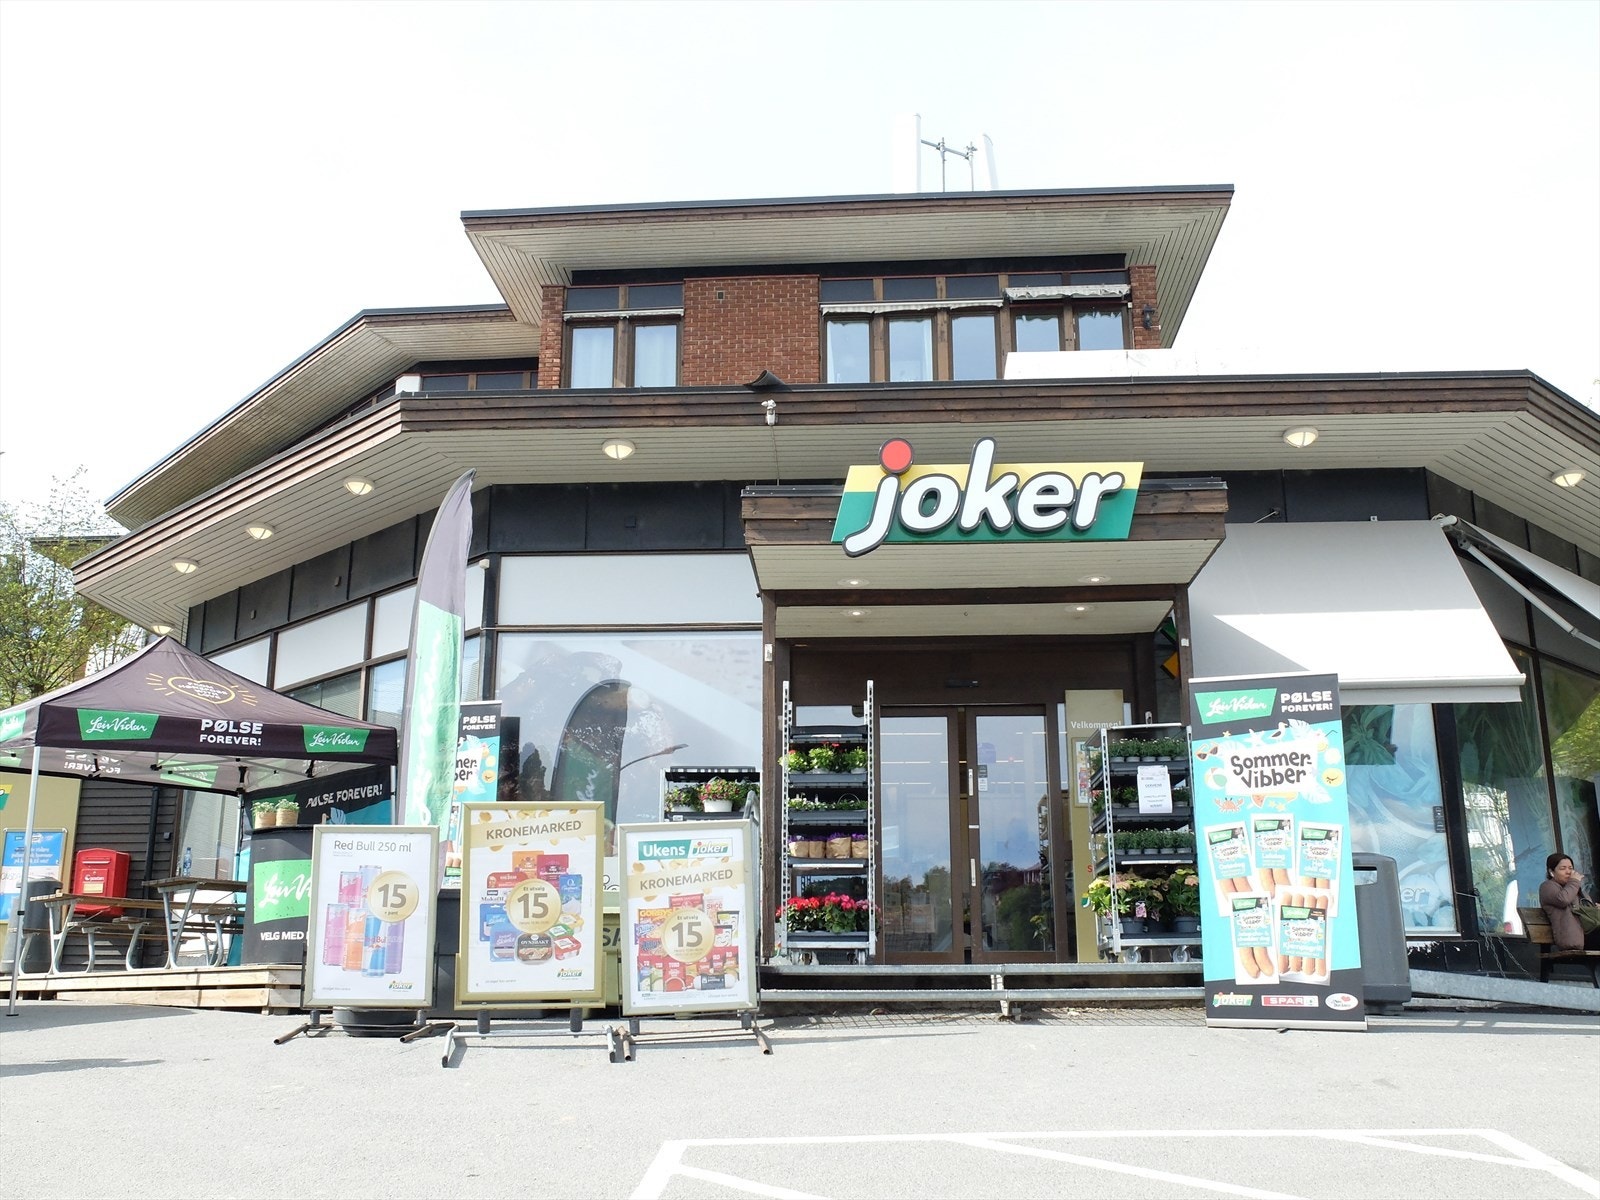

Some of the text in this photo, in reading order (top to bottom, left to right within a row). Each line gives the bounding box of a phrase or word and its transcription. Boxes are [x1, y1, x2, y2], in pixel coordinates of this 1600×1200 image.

[842, 436, 1125, 558] joker
[1280, 691, 1332, 703] PØLSE
[1281, 703, 1333, 713] FOREVER!
[113, 716, 148, 732] Vidar
[200, 719, 264, 735] PØLSE
[462, 715, 497, 724] PØLSE
[1070, 721, 1121, 730] Velkommen!
[199, 734, 262, 746] FOREVER!
[1241, 767, 1306, 789] Vibber
[306, 784, 383, 808] PØLSE FOREVER!
[486, 820, 582, 840] KRONEMARKED
[333, 840, 412, 852] Red Bull 250 ml
[642, 841, 727, 857] Ukens joker
[640, 869, 733, 891] KRONEMARKED
[378, 883, 407, 909] 15
[517, 892, 549, 919] 15
[260, 932, 281, 941] VELG
[281, 931, 304, 940] MED
[671, 921, 703, 948] 15
[1213, 992, 1249, 1008] joker
[1269, 997, 1304, 1006] SPAR
